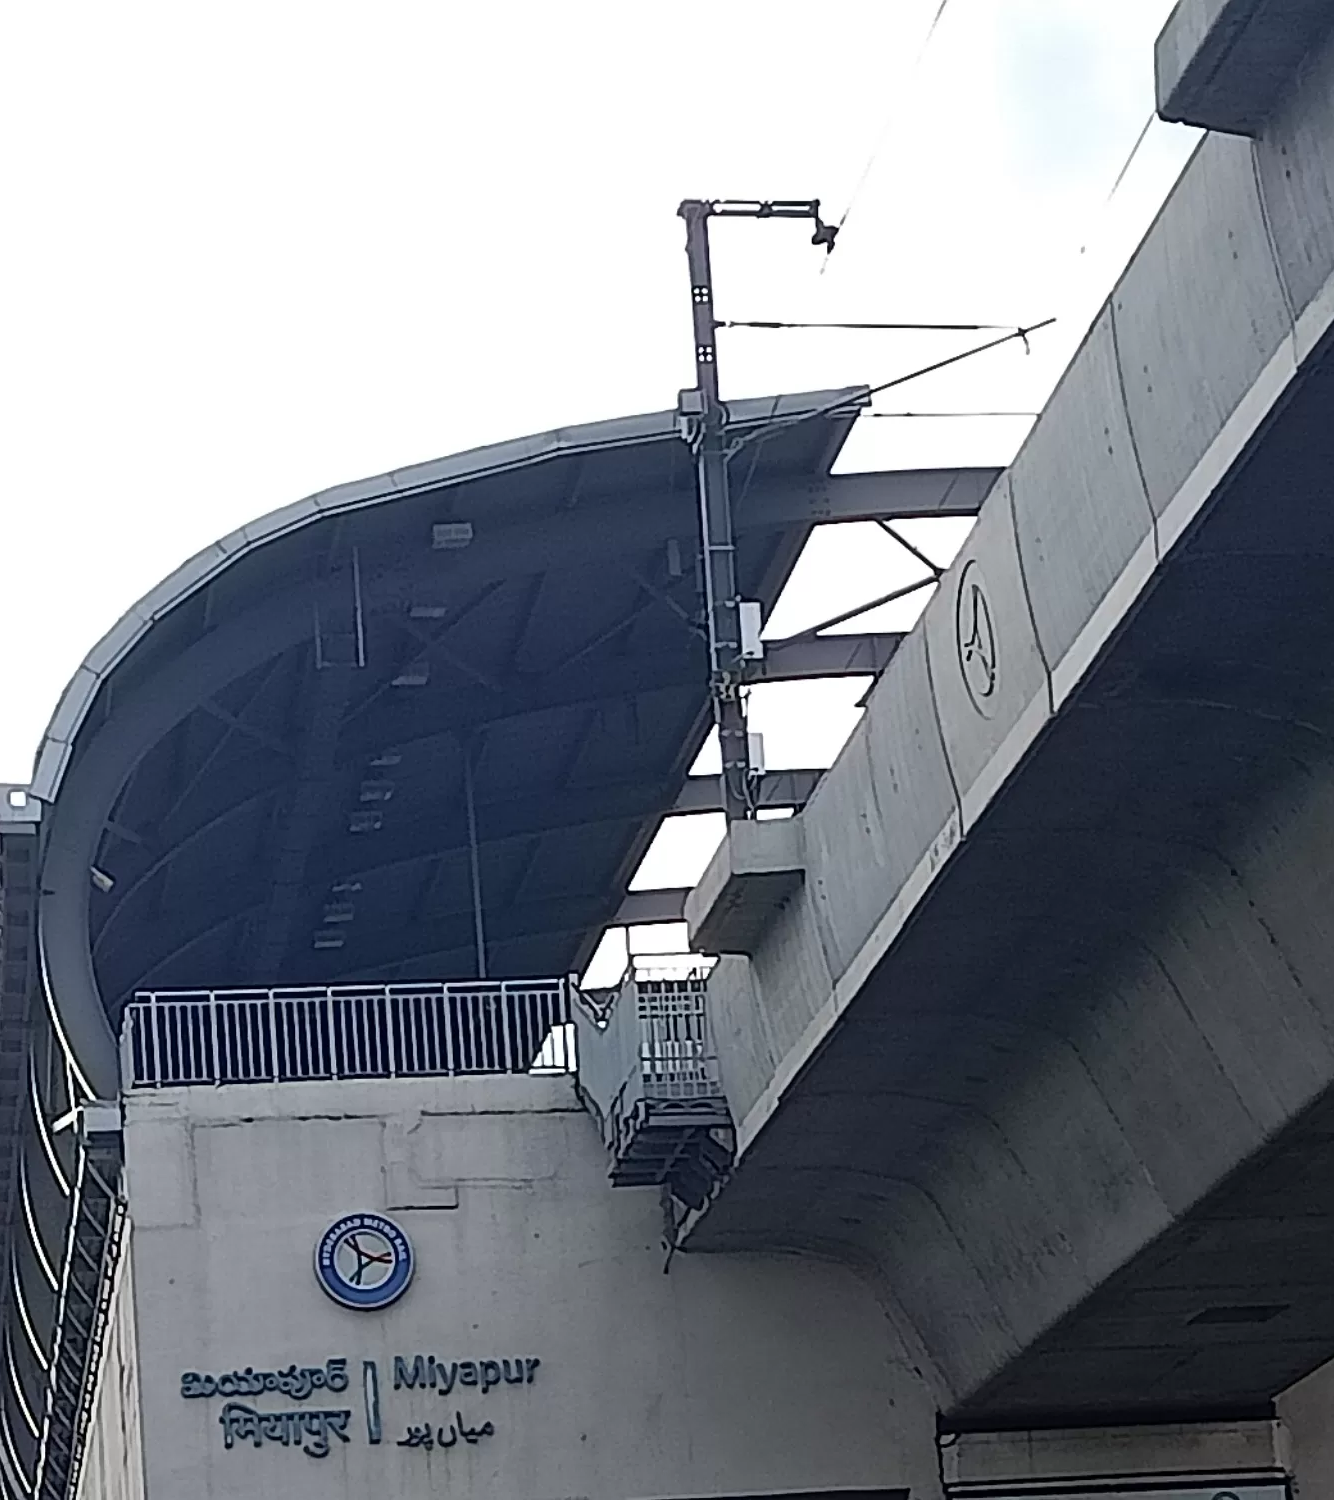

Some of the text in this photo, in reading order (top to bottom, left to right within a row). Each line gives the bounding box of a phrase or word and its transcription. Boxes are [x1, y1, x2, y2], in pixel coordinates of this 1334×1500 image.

[181, 1358, 349, 1400] మియాపూర్
[394, 1355, 540, 1396] Miyapur
[219, 1401, 352, 1458] मियापुर
